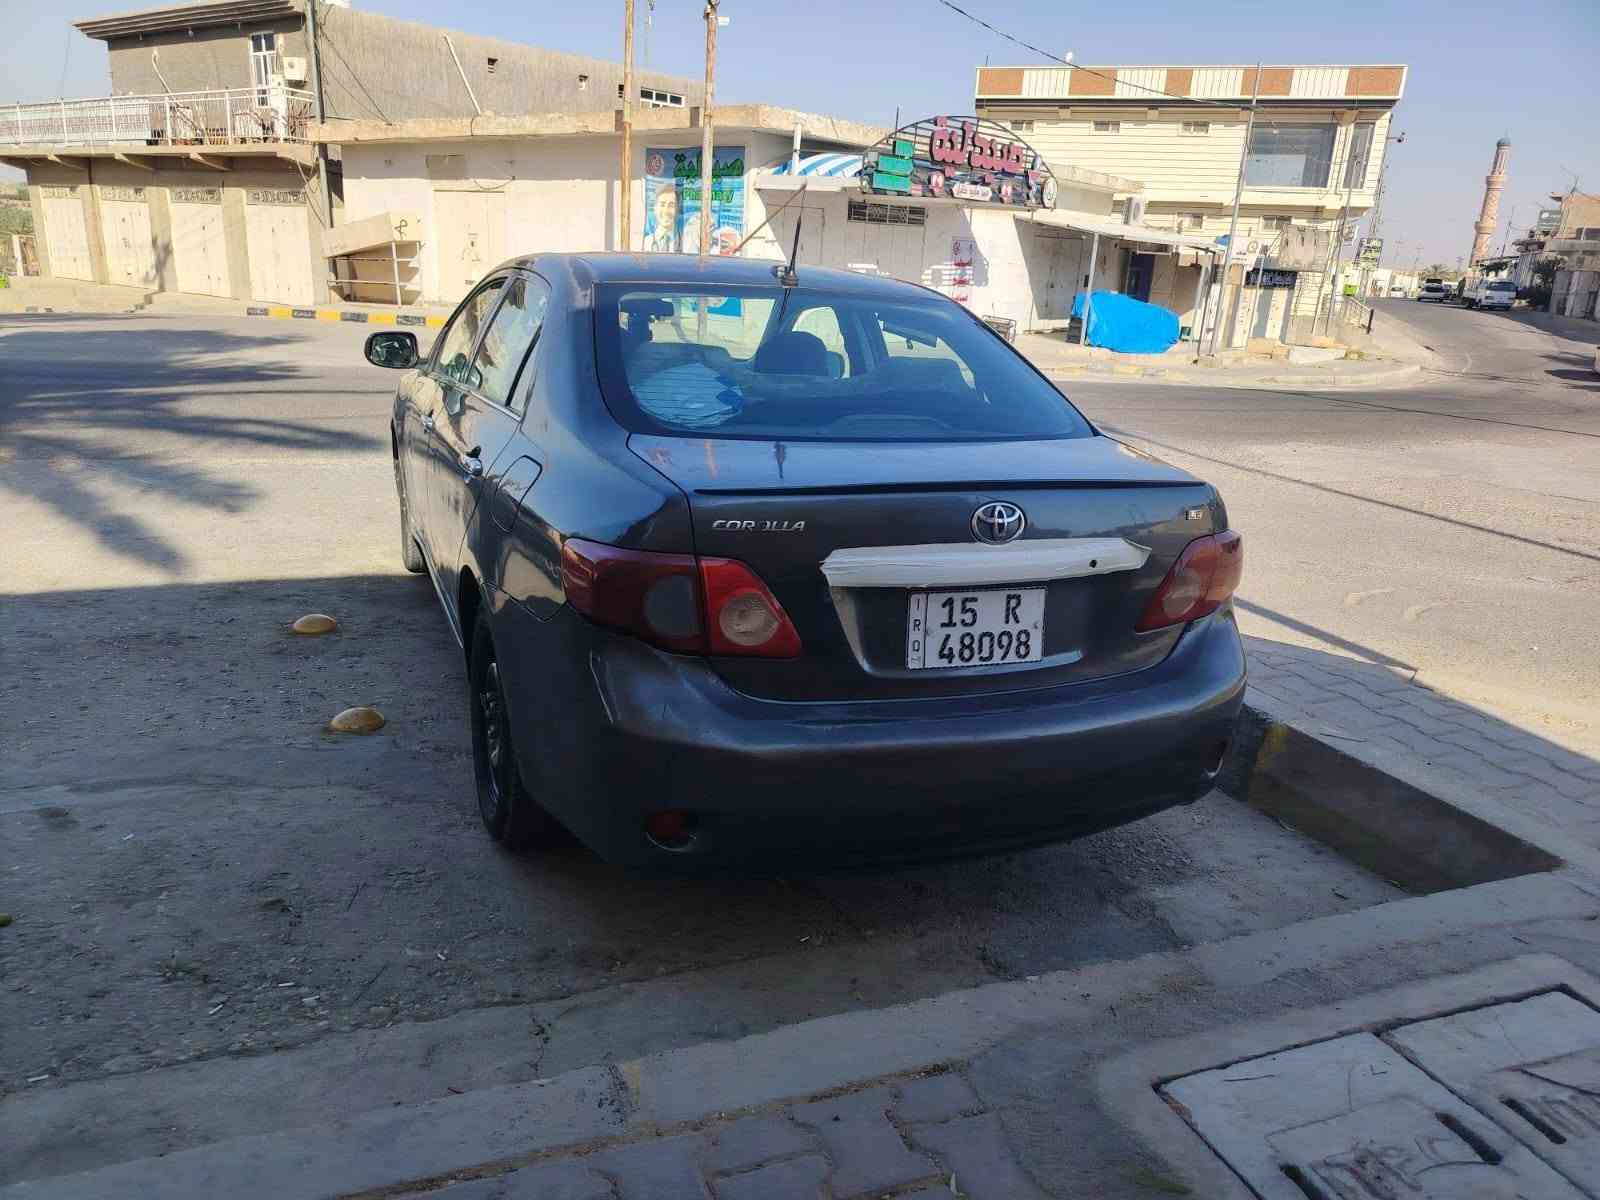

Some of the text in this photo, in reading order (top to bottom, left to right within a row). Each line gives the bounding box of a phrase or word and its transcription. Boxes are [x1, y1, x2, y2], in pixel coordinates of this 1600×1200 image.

[673, 153, 744, 183] صيلية
[683, 189, 735, 203] Phaacy
[940, 594, 1022, 628] 15 R
[938, 629, 1032, 664] 48098
